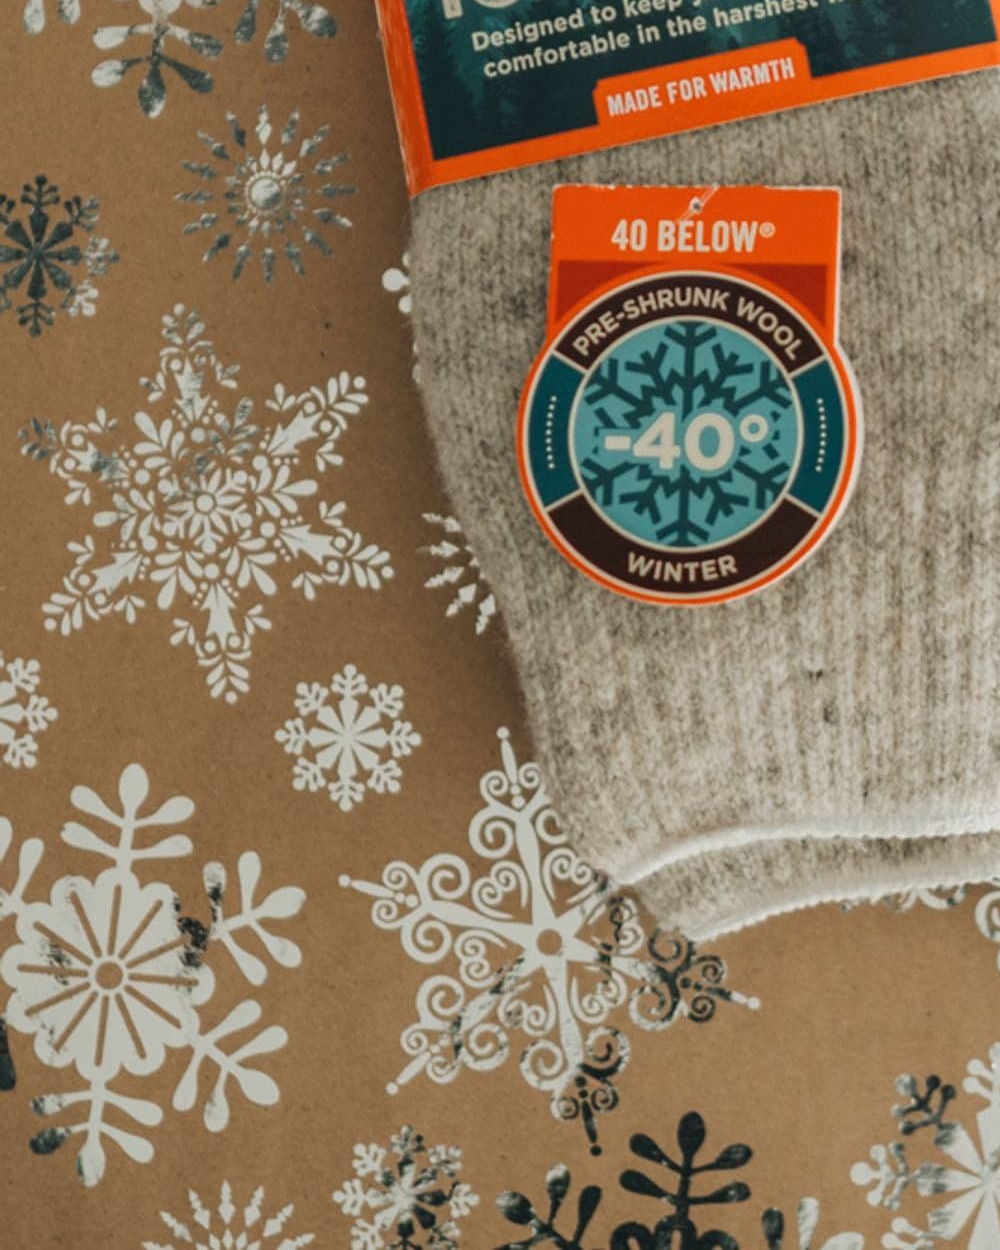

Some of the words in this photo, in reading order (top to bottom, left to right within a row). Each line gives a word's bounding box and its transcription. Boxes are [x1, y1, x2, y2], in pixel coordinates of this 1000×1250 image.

[471, 7, 584, 52] Designed
[590, 4, 617, 25] to
[483, 29, 631, 79] comfortable
[636, 23, 661, 45] in
[666, 15, 707, 39] the
[606, 85, 663, 117] MADE
[666, 75, 708, 105] FOR
[709, 56, 796, 96] WARMTH
[611, 219, 648, 251] 40
[572, 287, 730, 356] PRE-SHRUNK
[736, 297, 803, 361] WOOL
[627, 552, 738, 583] WINTER
